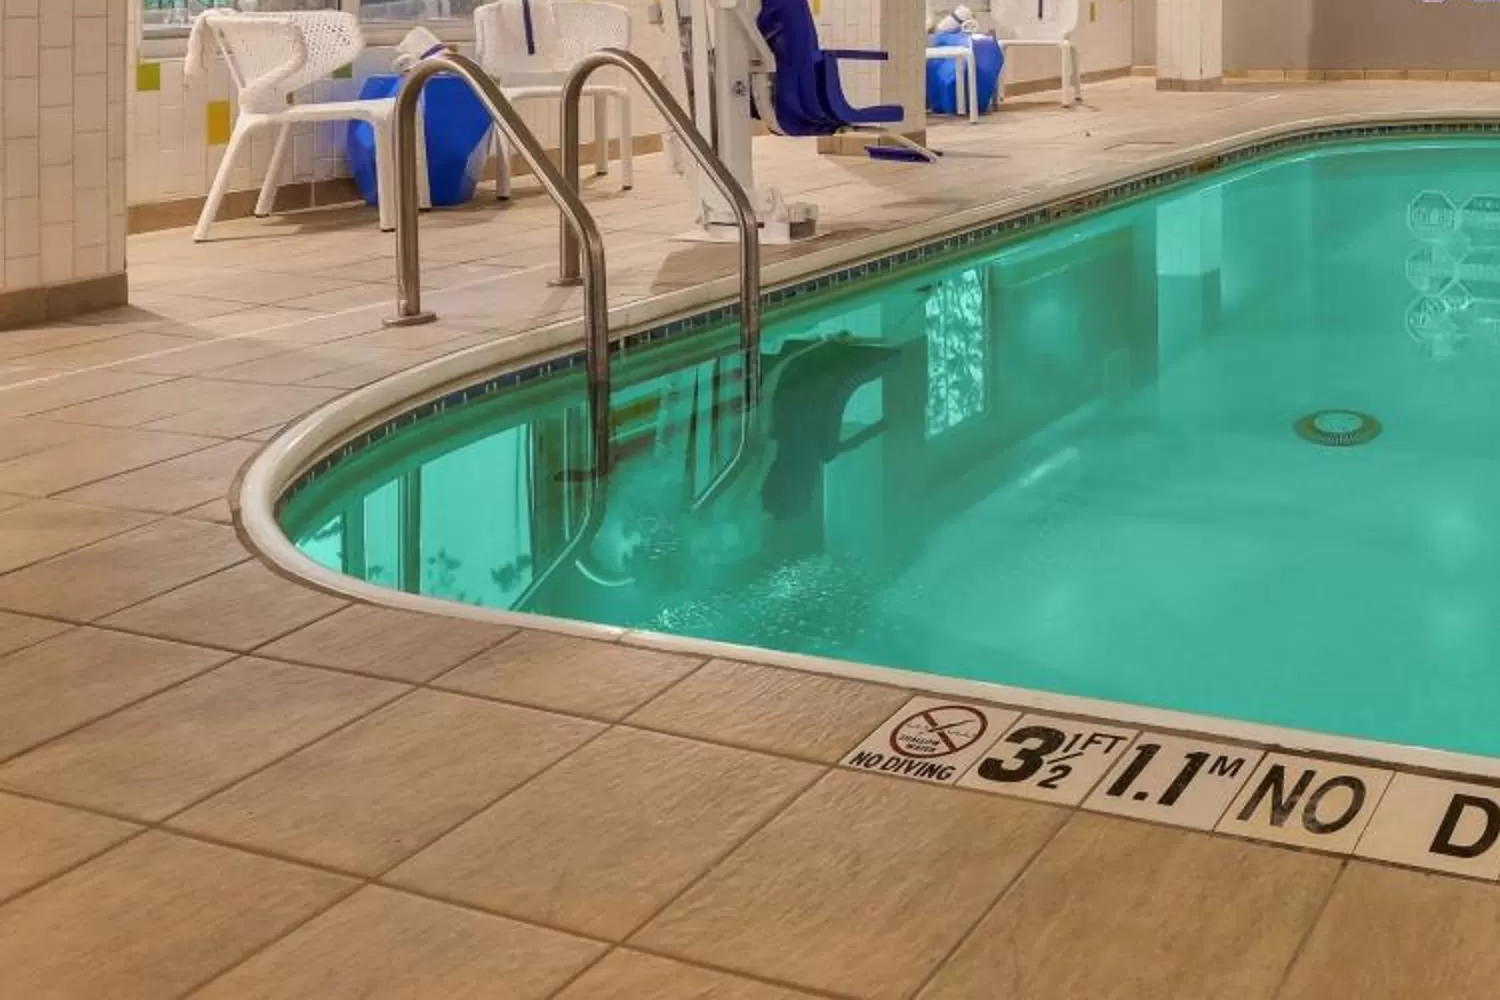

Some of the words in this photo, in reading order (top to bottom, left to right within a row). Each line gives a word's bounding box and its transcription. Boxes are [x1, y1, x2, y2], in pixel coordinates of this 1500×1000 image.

[851, 750, 880, 769] NO
[881, 757, 957, 781] DIVING
[1236, 763, 1367, 835] NO
